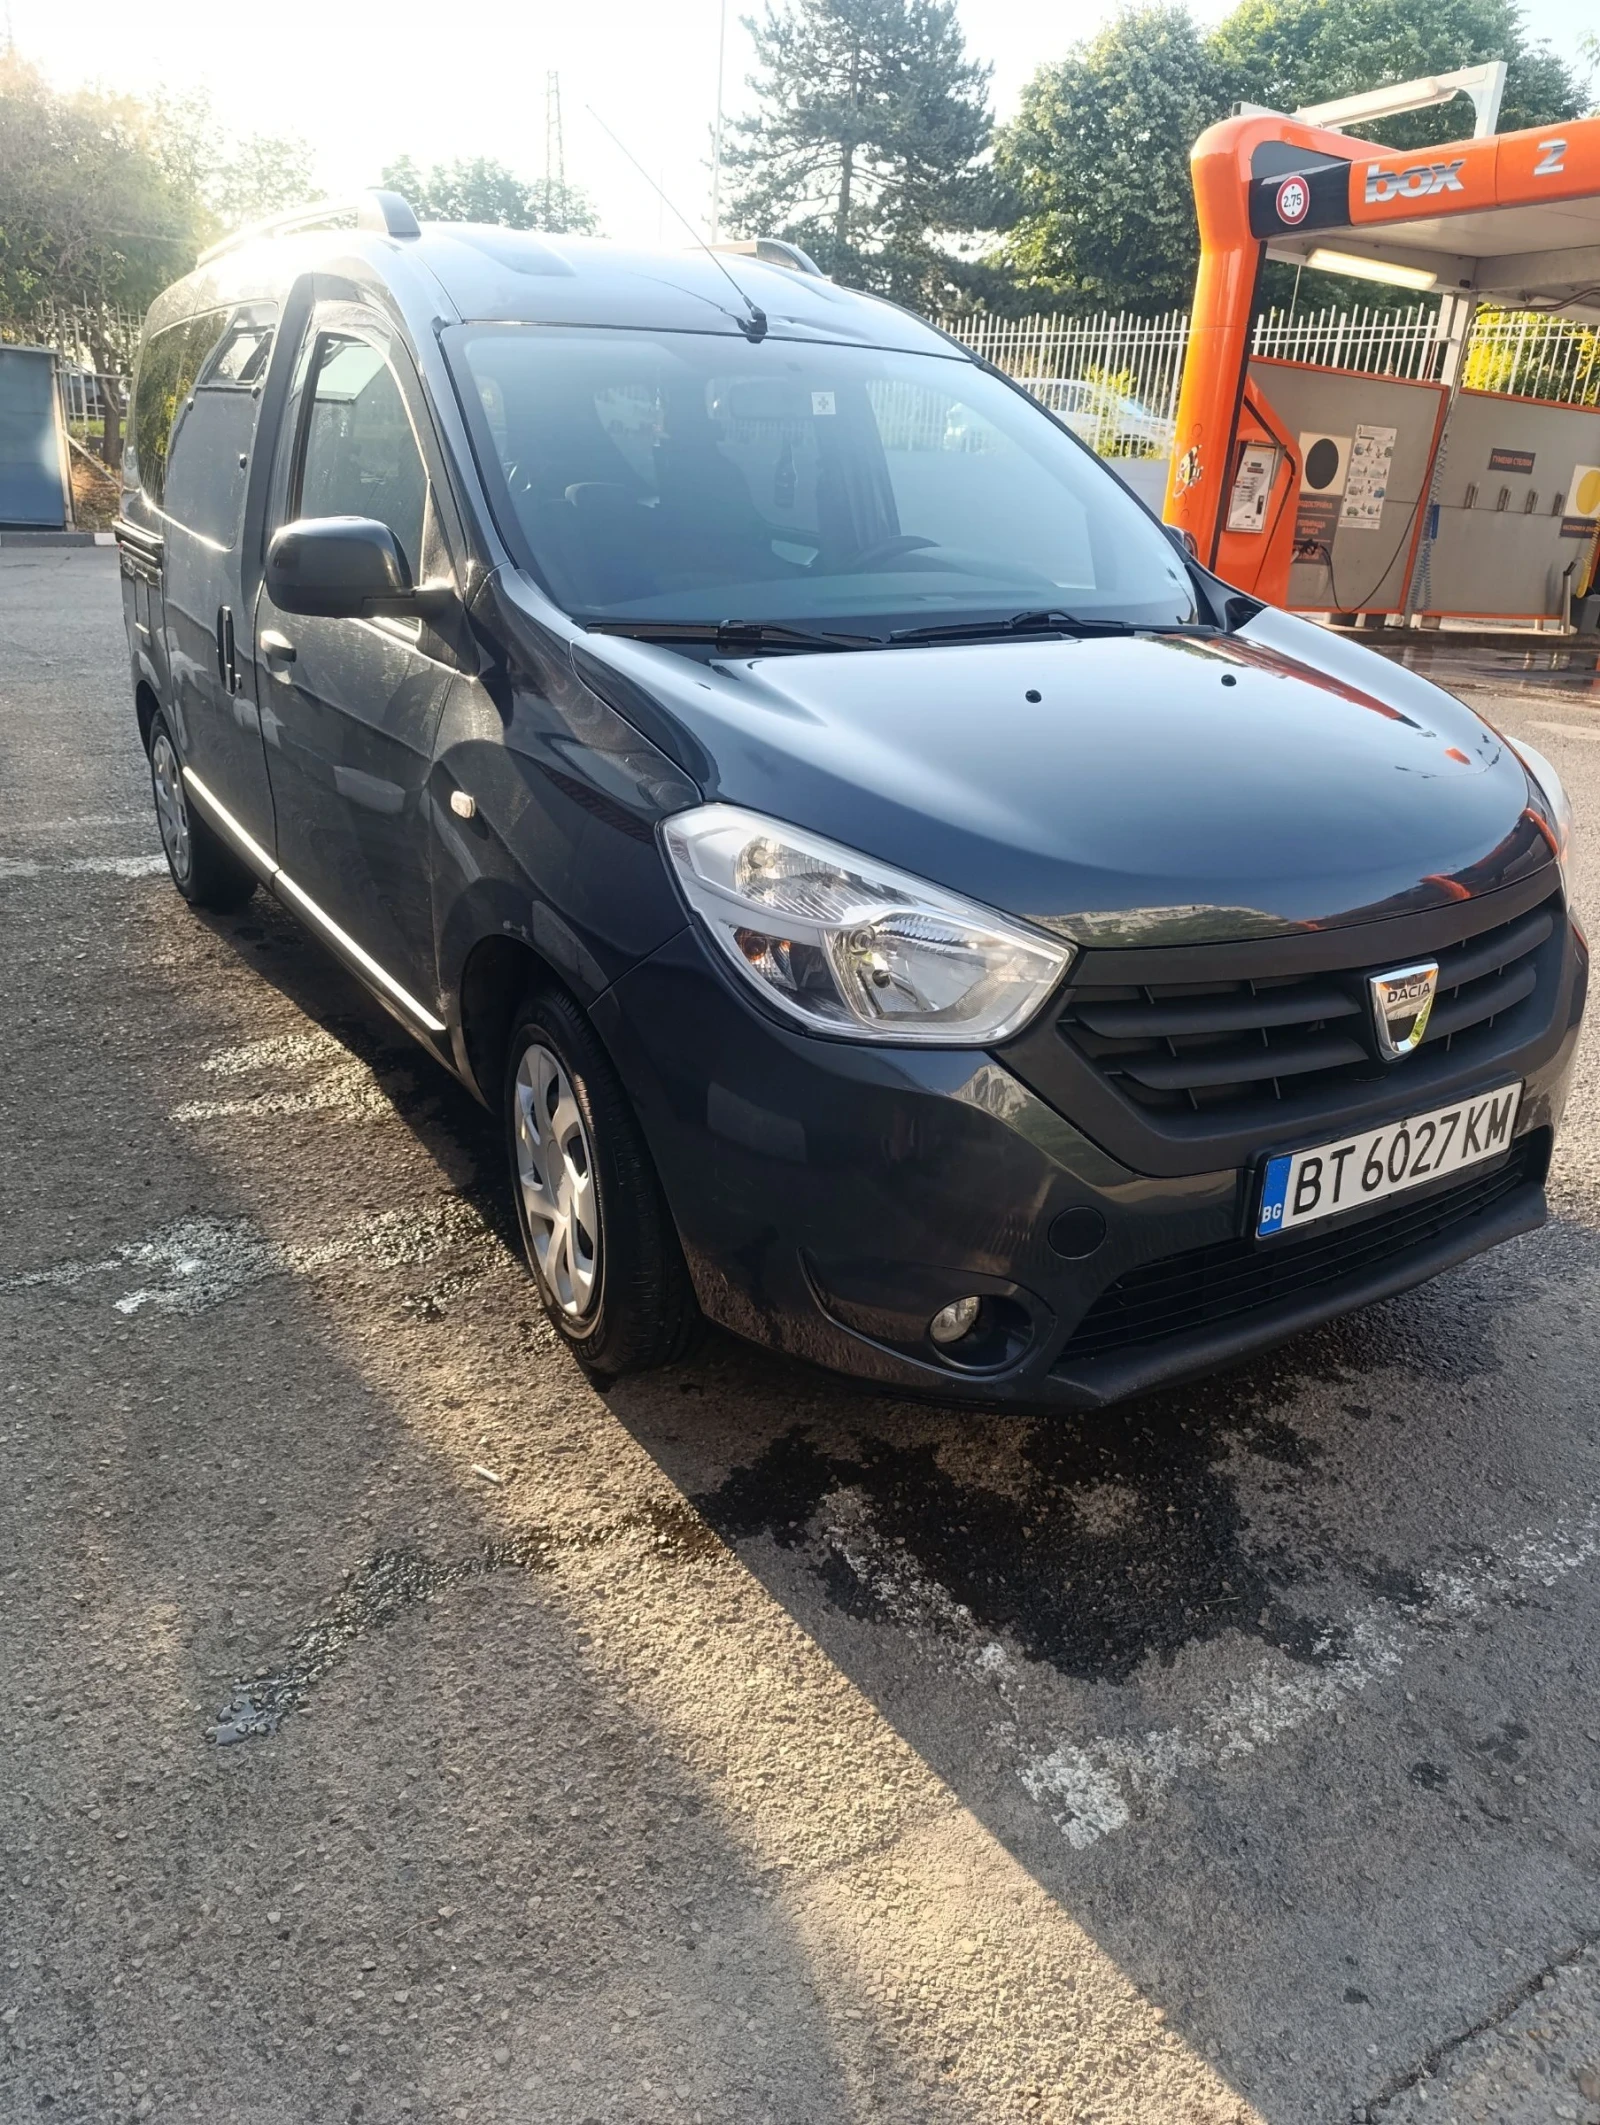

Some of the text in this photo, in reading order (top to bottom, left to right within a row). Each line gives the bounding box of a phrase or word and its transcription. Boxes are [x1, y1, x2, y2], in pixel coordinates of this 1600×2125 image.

[1365, 138, 1568, 204] box 2
[1283, 193, 1302, 208] 2.75
[1386, 982, 1431, 1003] DACIA
[1292, 1092, 1514, 1216] BT 6027 KM
[1261, 1203, 1282, 1224] BG
